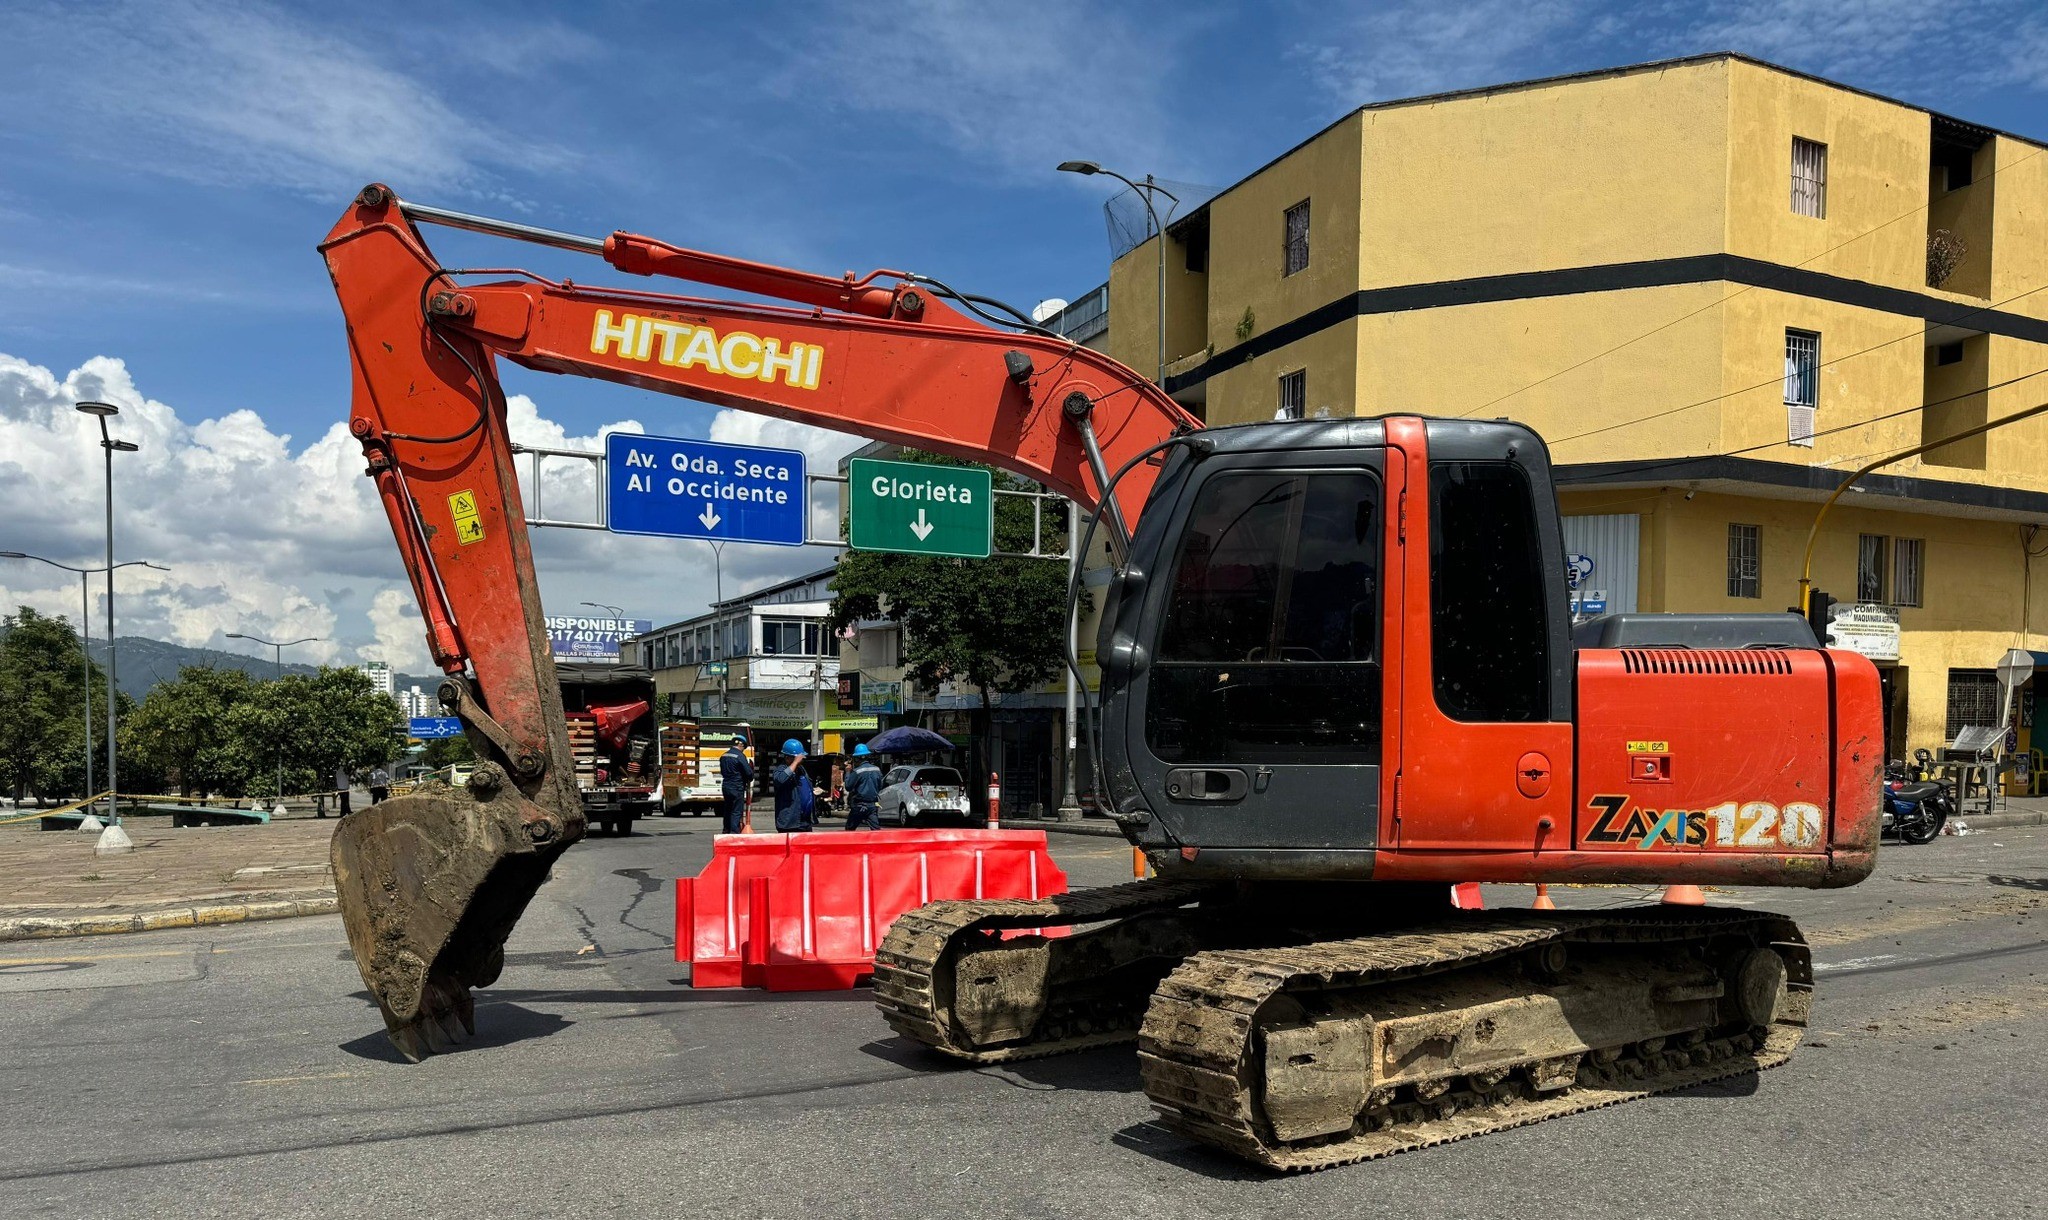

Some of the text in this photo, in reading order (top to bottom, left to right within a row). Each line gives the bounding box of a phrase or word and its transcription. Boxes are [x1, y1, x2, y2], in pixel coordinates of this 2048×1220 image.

[591, 310, 823, 389] HITACHI
[625, 449, 789, 481] Av. Qda. Seca
[626, 473, 788, 504] Al Occidente
[871, 476, 972, 504] Glorieta
[544, 617, 635, 632] DISPONIBLE
[1854, 605, 1899, 615] COMPRAVENTA
[546, 630, 643, 643] 317407736
[1708, 802, 1824, 847] 120
